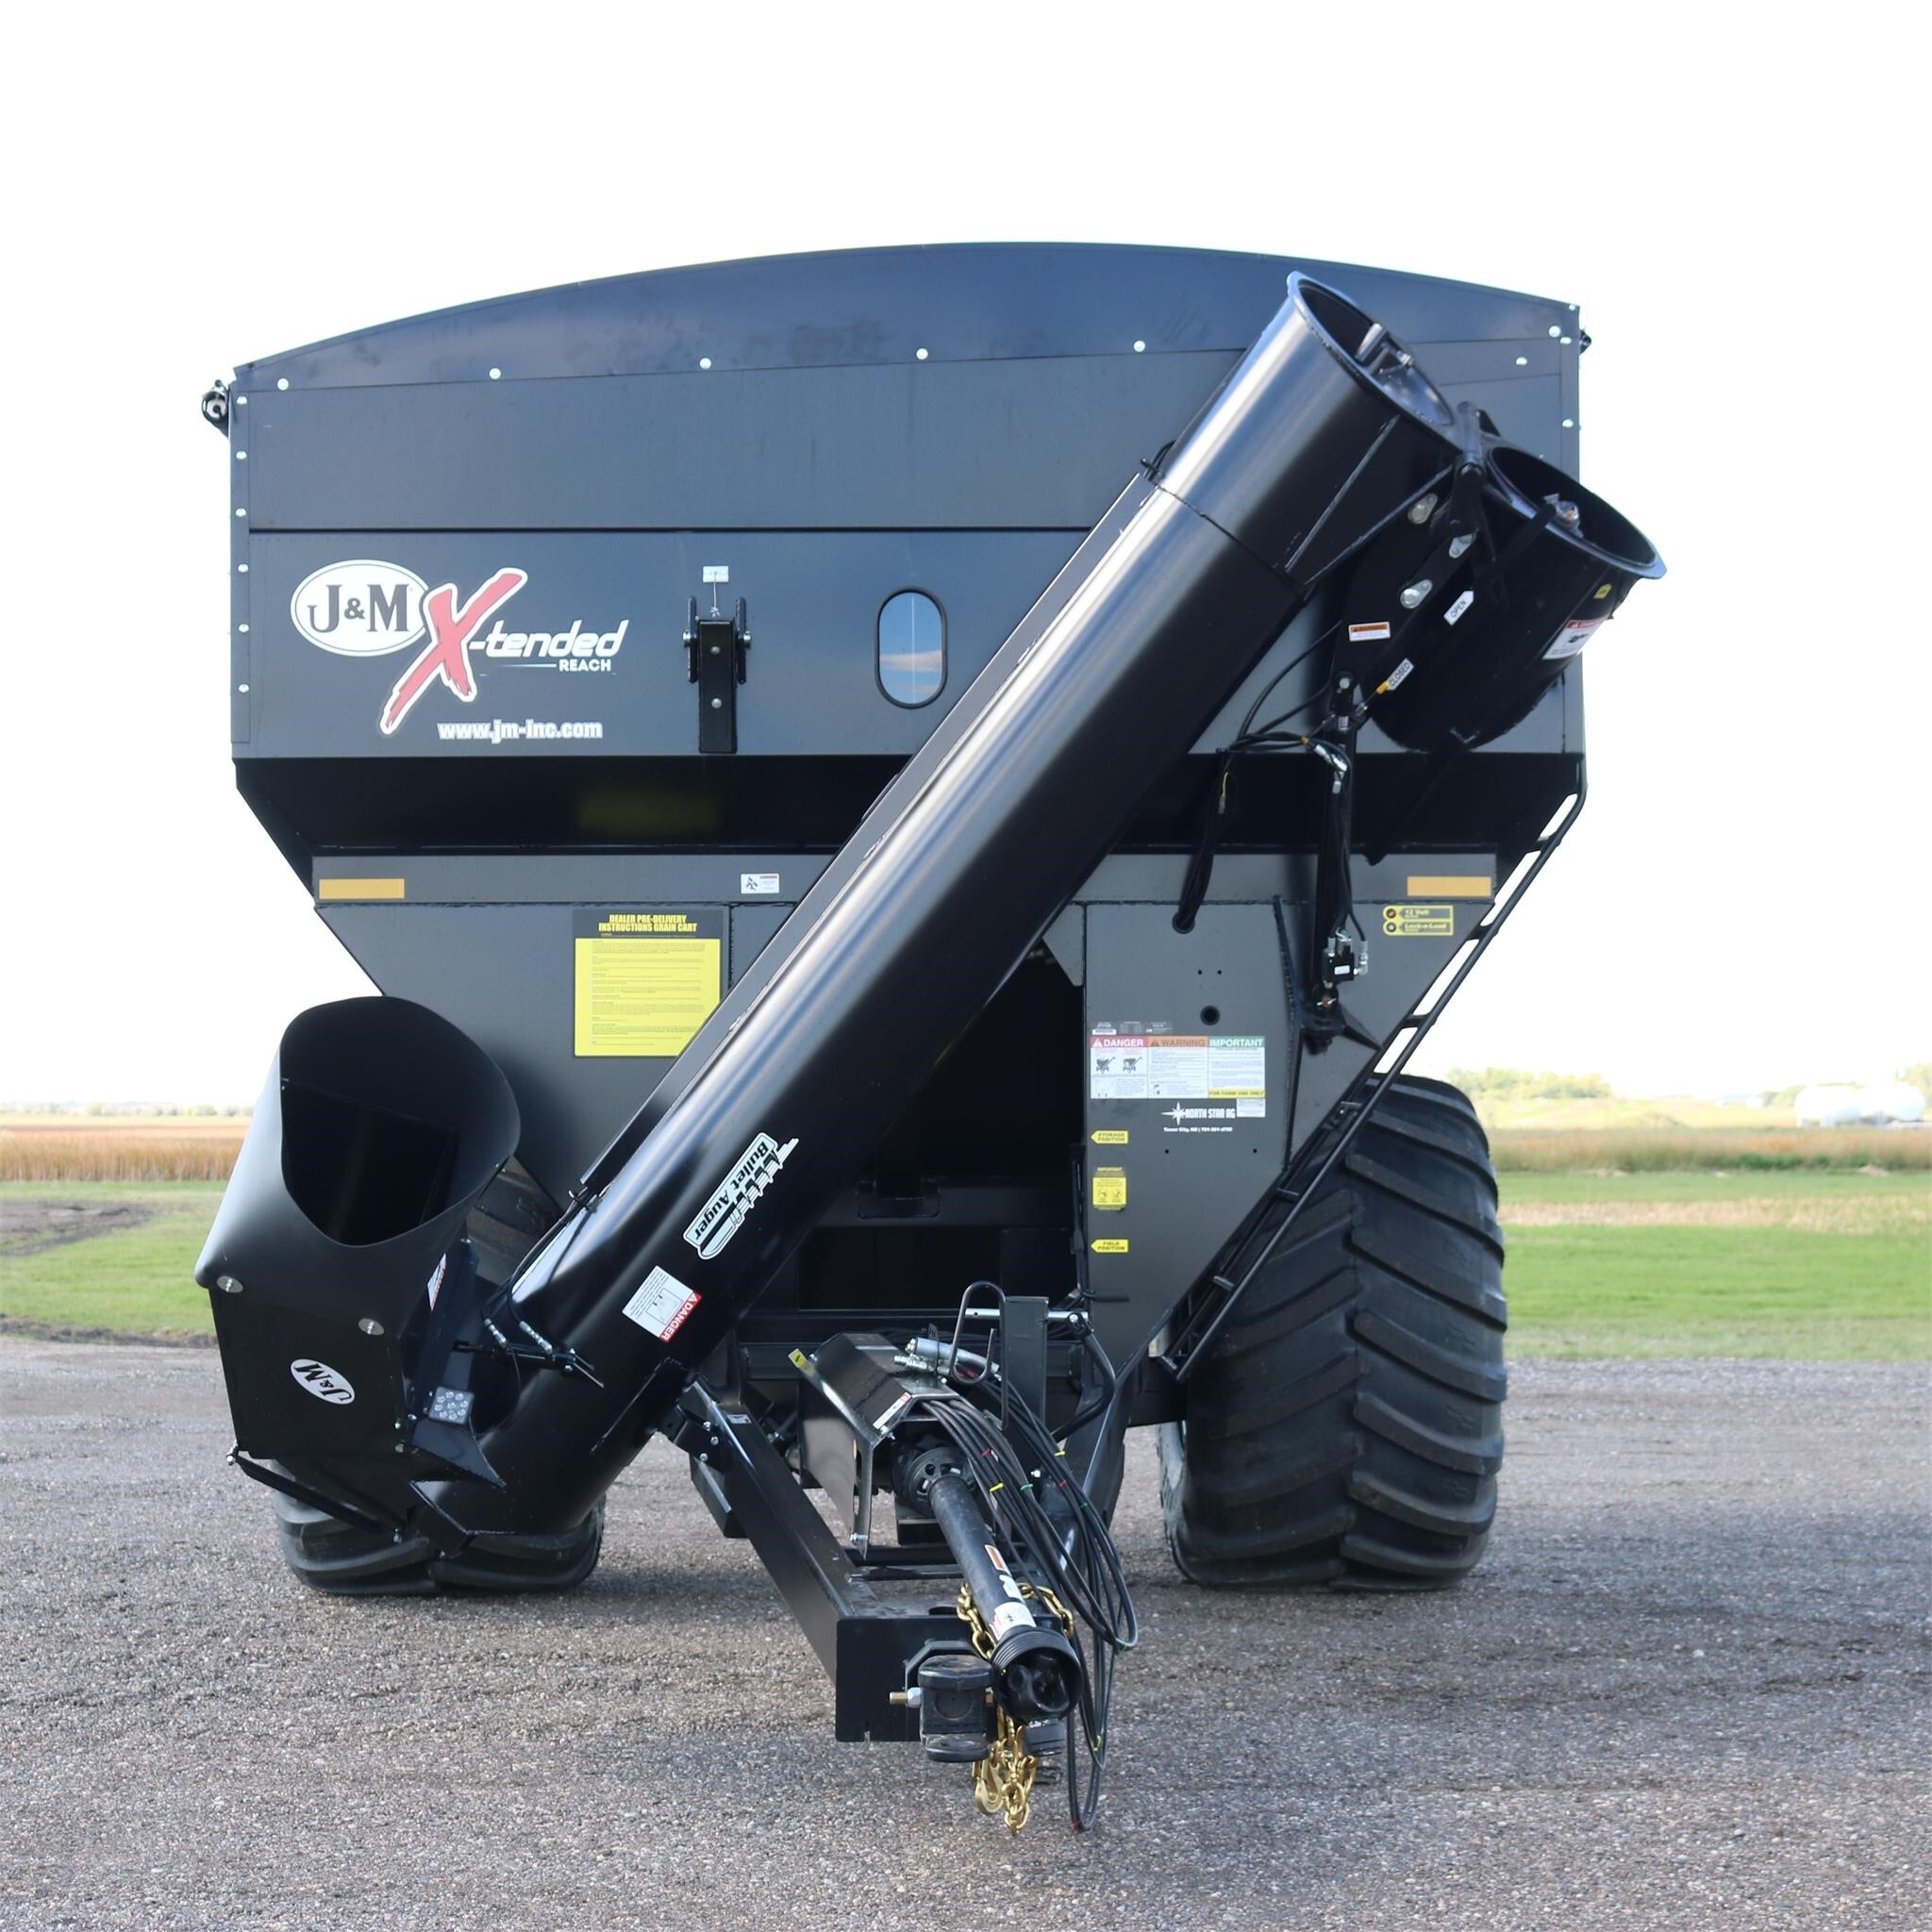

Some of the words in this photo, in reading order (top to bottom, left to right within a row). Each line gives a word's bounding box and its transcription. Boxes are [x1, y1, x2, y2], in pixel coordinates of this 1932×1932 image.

[307, 584, 409, 633] J&M
[558, 659, 611, 672] REACH
[1389, 661, 1410, 687] CLOSED
[437, 719, 603, 743] www.jm-inc.com
[599, 923, 653, 932] INSTRUCTIONS
[654, 923, 676, 932] GRAIN
[677, 923, 698, 932] CART
[609, 914, 636, 923] DEALER
[637, 914, 687, 923] PRE-DELIVERY
[1103, 1039, 1143, 1047] DANGER
[1161, 1039, 1206, 1047] WARNING
[1209, 1039, 1263, 1047] IMPORTANT
[1185, 1108, 1207, 1119] NORTH
[1208, 1108, 1224, 1119] STAR
[730, 1141, 769, 1191] Bullet
[694, 1190, 730, 1240] Auger
[660, 1302, 694, 1341] DANGER
[293, 1363, 352, 1401] J&M
